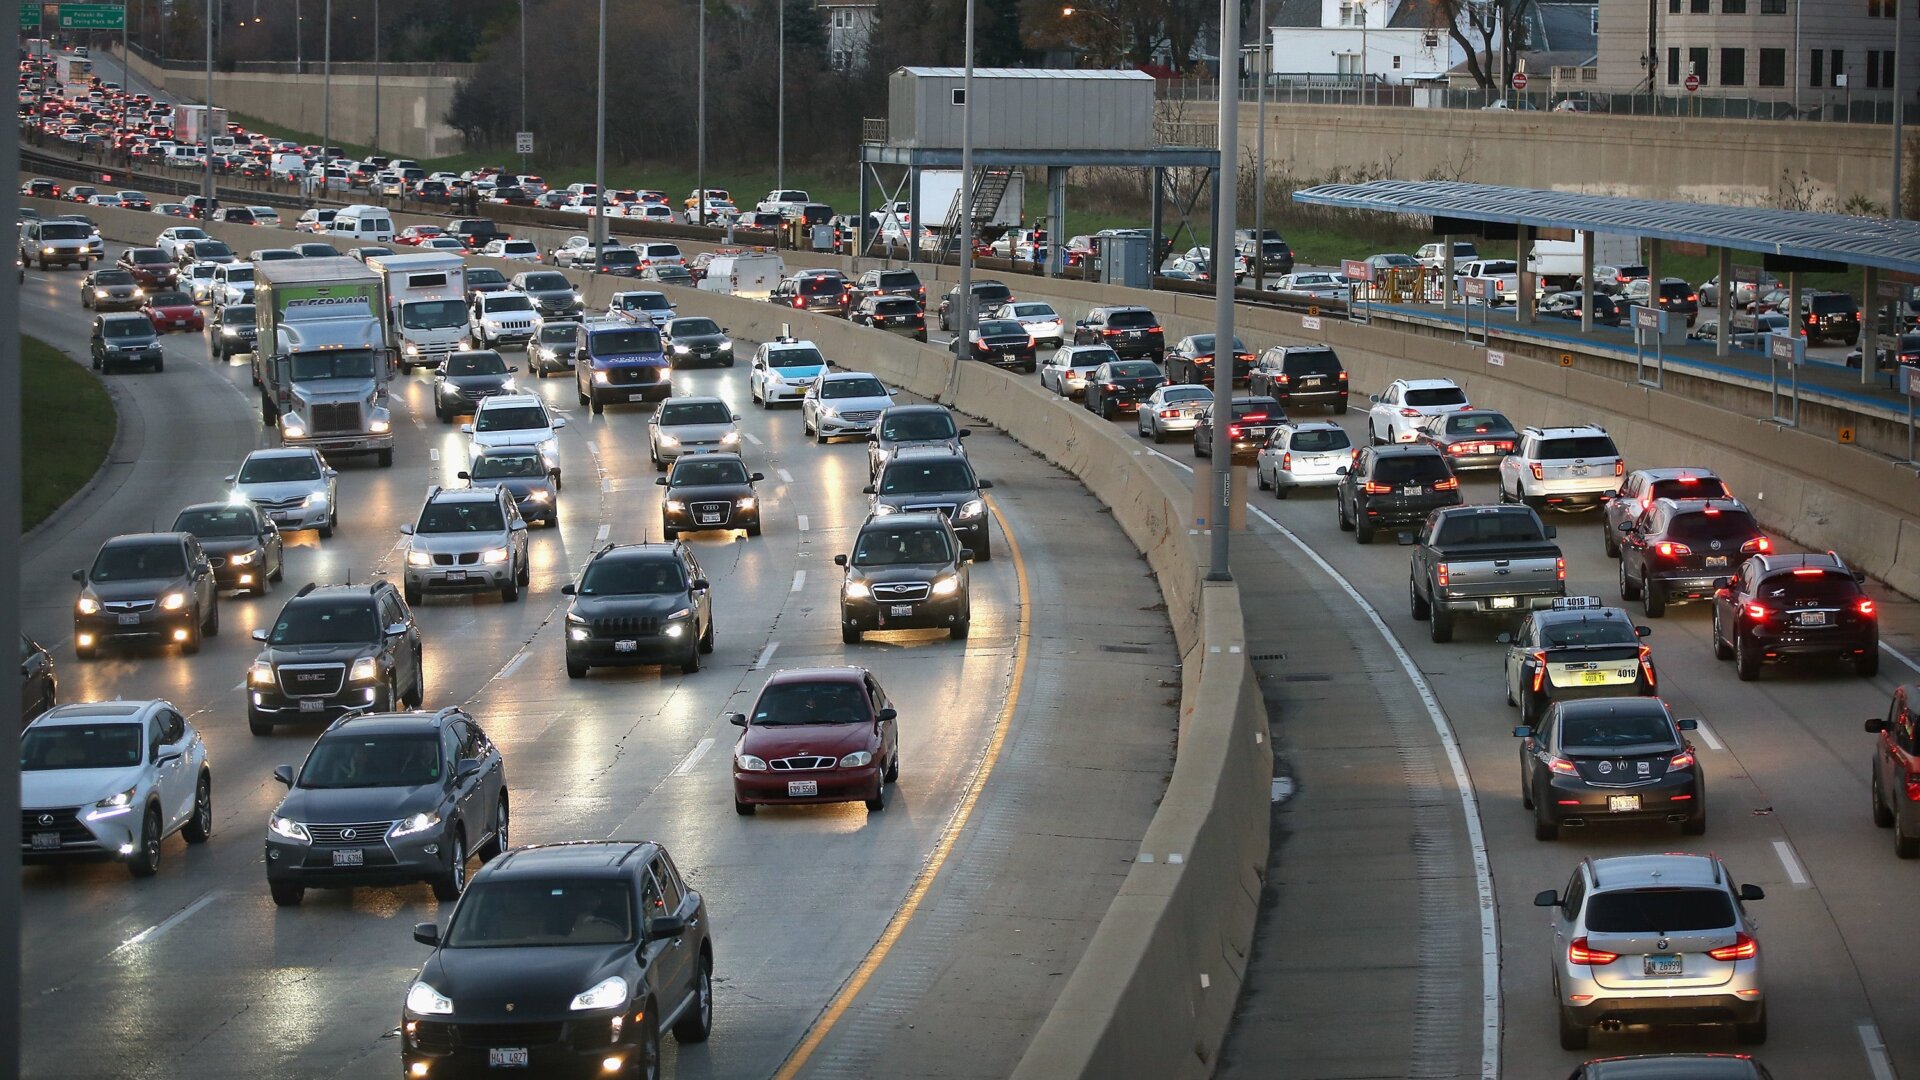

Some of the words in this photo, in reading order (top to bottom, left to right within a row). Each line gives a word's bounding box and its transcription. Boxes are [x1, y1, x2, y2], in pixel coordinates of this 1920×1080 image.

[1466, 281, 1479, 293] Addison
[1638, 312, 1652, 327] Addison
[1773, 340, 1787, 357] Addison
[1562, 356, 1569, 364] 6
[1842, 430, 1850, 440] 4
[1567, 598, 1585, 606] 4018
[1617, 669, 1636, 678] 4018
[1660, 960, 1680, 971] 26999
[509, 1052, 527, 1063] 4827
